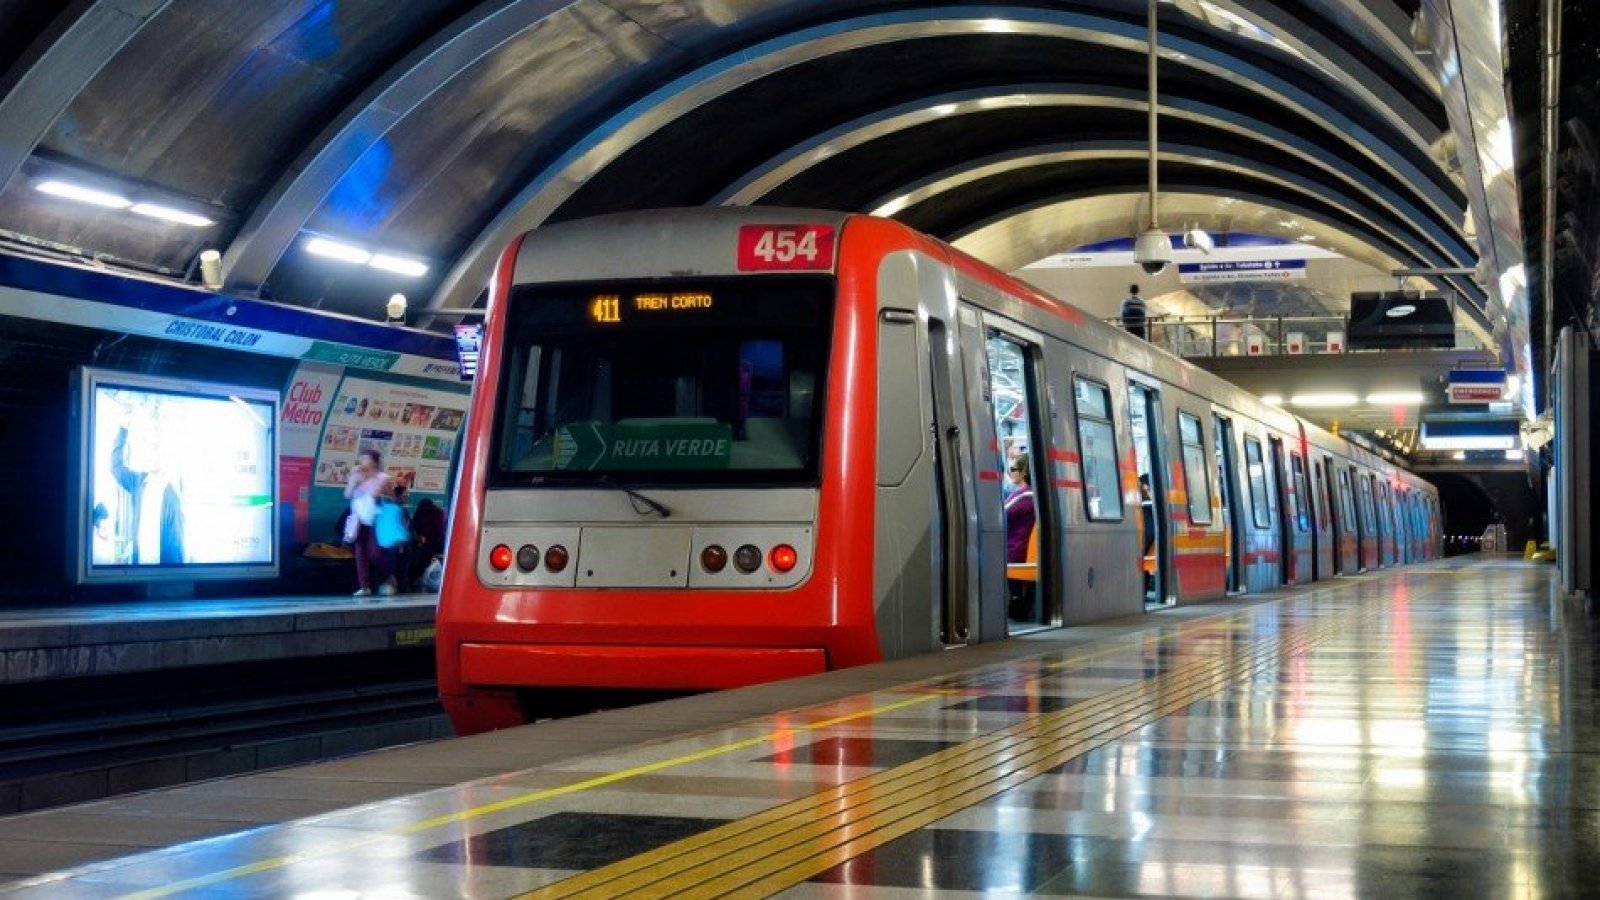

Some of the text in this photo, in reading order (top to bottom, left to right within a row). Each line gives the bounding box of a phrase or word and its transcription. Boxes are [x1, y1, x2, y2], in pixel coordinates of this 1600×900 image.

[754, 230, 818, 262] 454
[592, 297, 621, 322] 411
[635, 295, 712, 310] TREN CORTO
[289, 381, 322, 404] Club
[281, 403, 323, 426] Metro
[611, 438, 728, 457] RUTA VERDE
